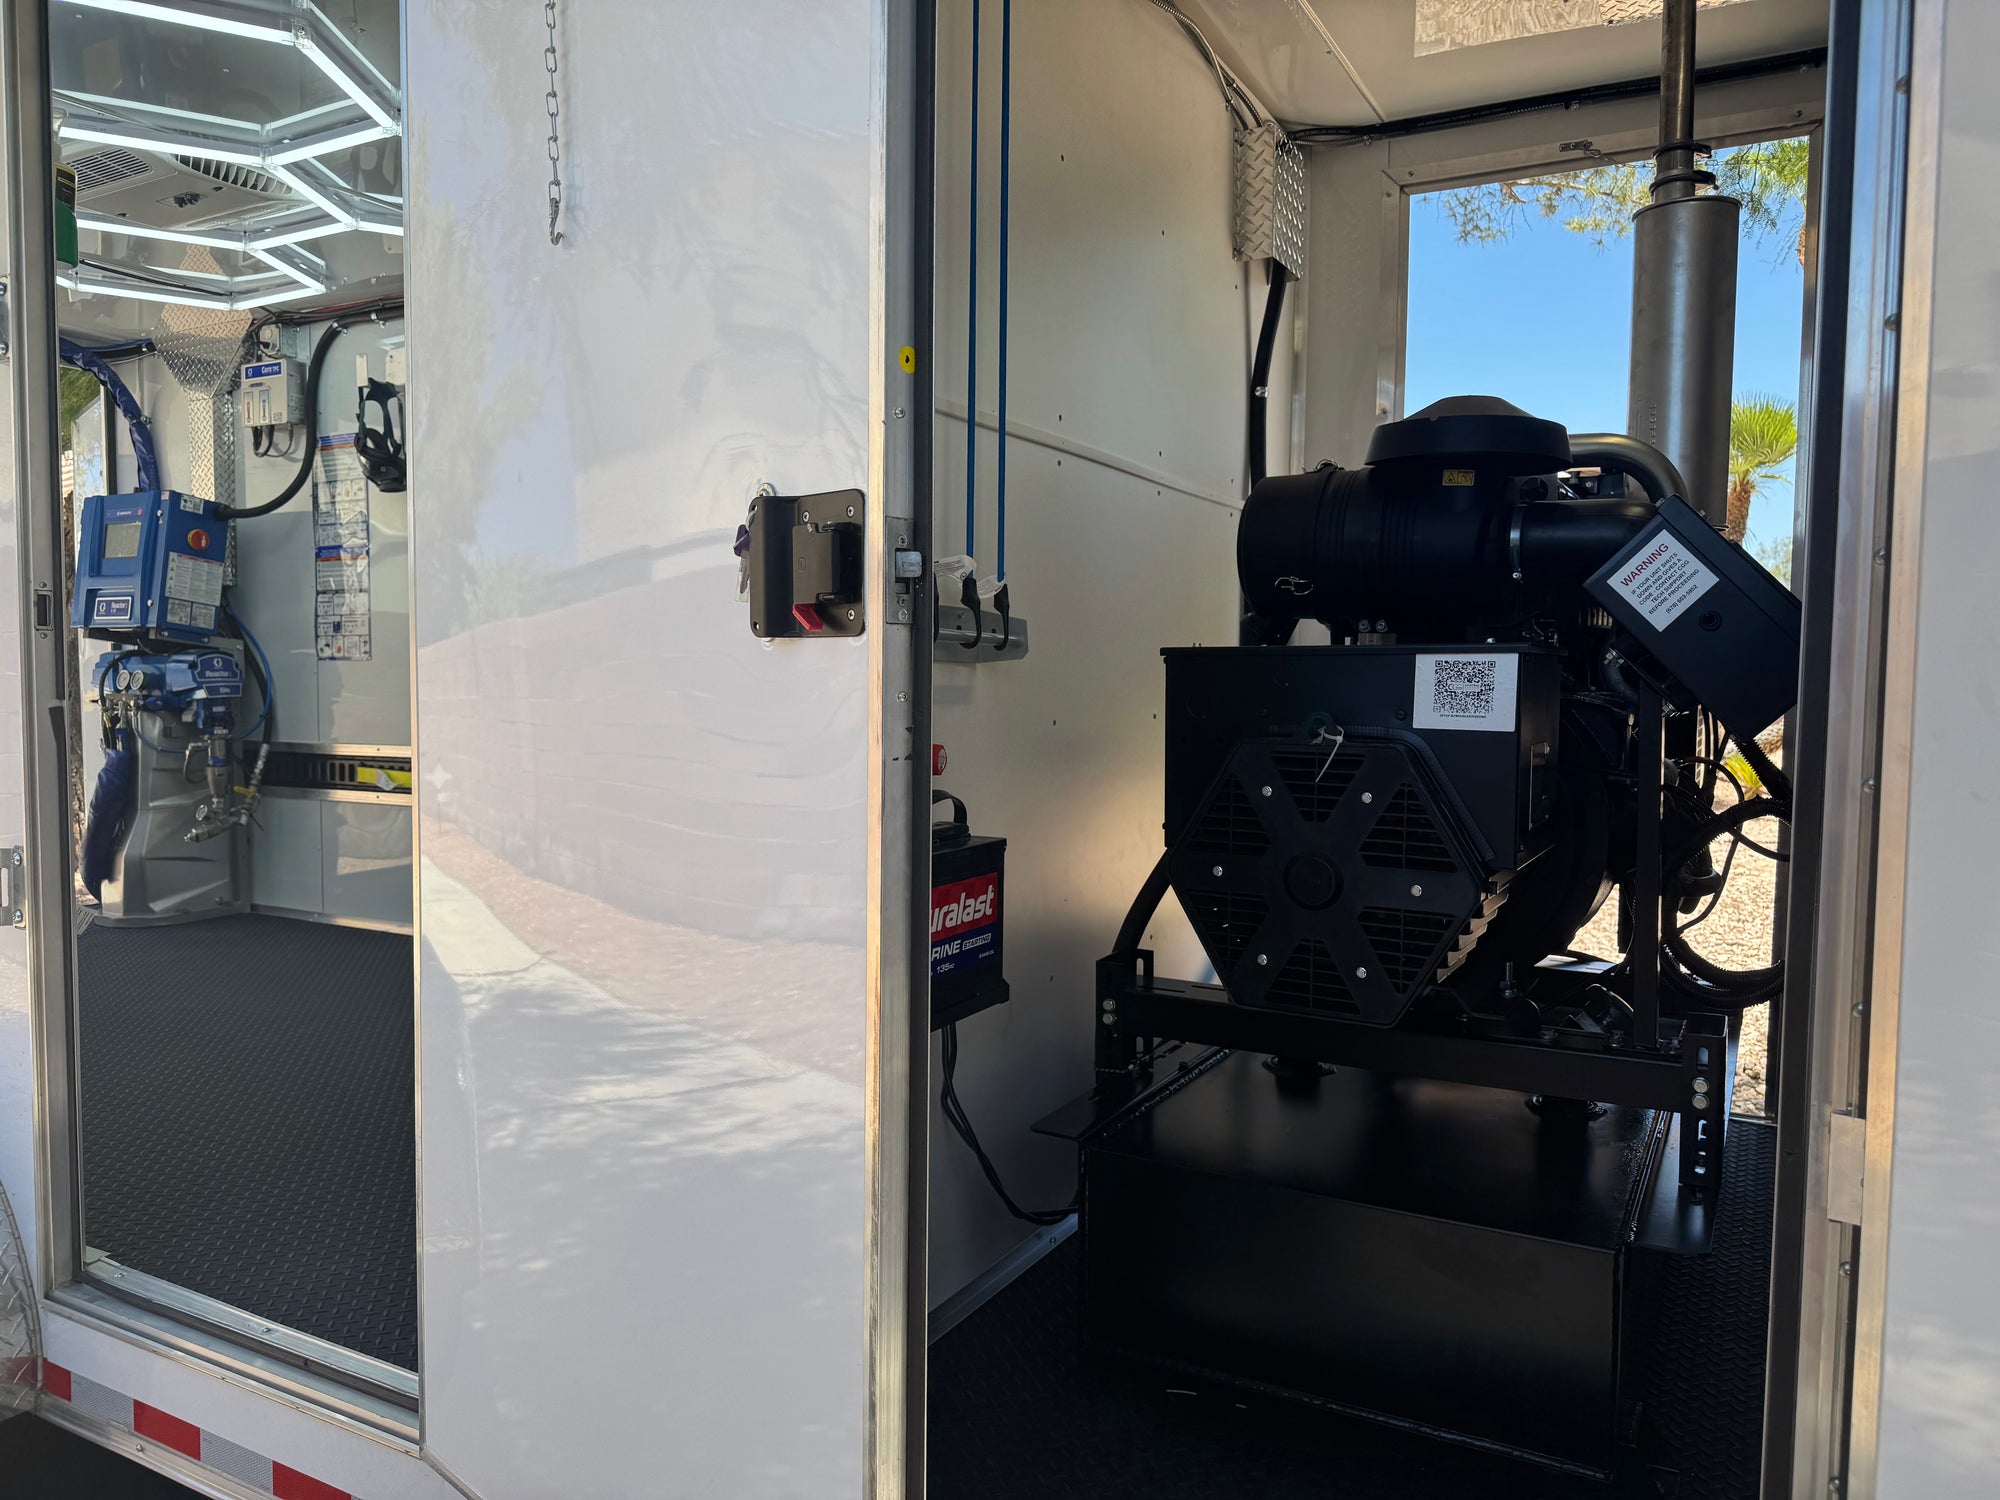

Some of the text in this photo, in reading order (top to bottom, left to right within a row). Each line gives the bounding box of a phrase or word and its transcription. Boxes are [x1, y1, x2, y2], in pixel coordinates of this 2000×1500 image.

[1620, 543, 1669, 587] WARNING
[1636, 576, 1651, 590] YOUR
[1650, 566, 1663, 579] UNIT
[1661, 552, 1678, 568] SHUTS
[1637, 584, 1653, 599] DOWN
[1652, 574, 1663, 586] AND
[1662, 562, 1678, 576] GIVES
[1639, 592, 1654, 606] CODE
[1655, 570, 1679, 592] CONTACT
[1648, 568, 1700, 615] BEFORE PROCEEDING
[1651, 570, 1687, 604] TECH SUPPORT
[931, 885, 995, 933] uralast
[931, 940, 961, 961] RINE
[963, 934, 991, 949] STARTING
